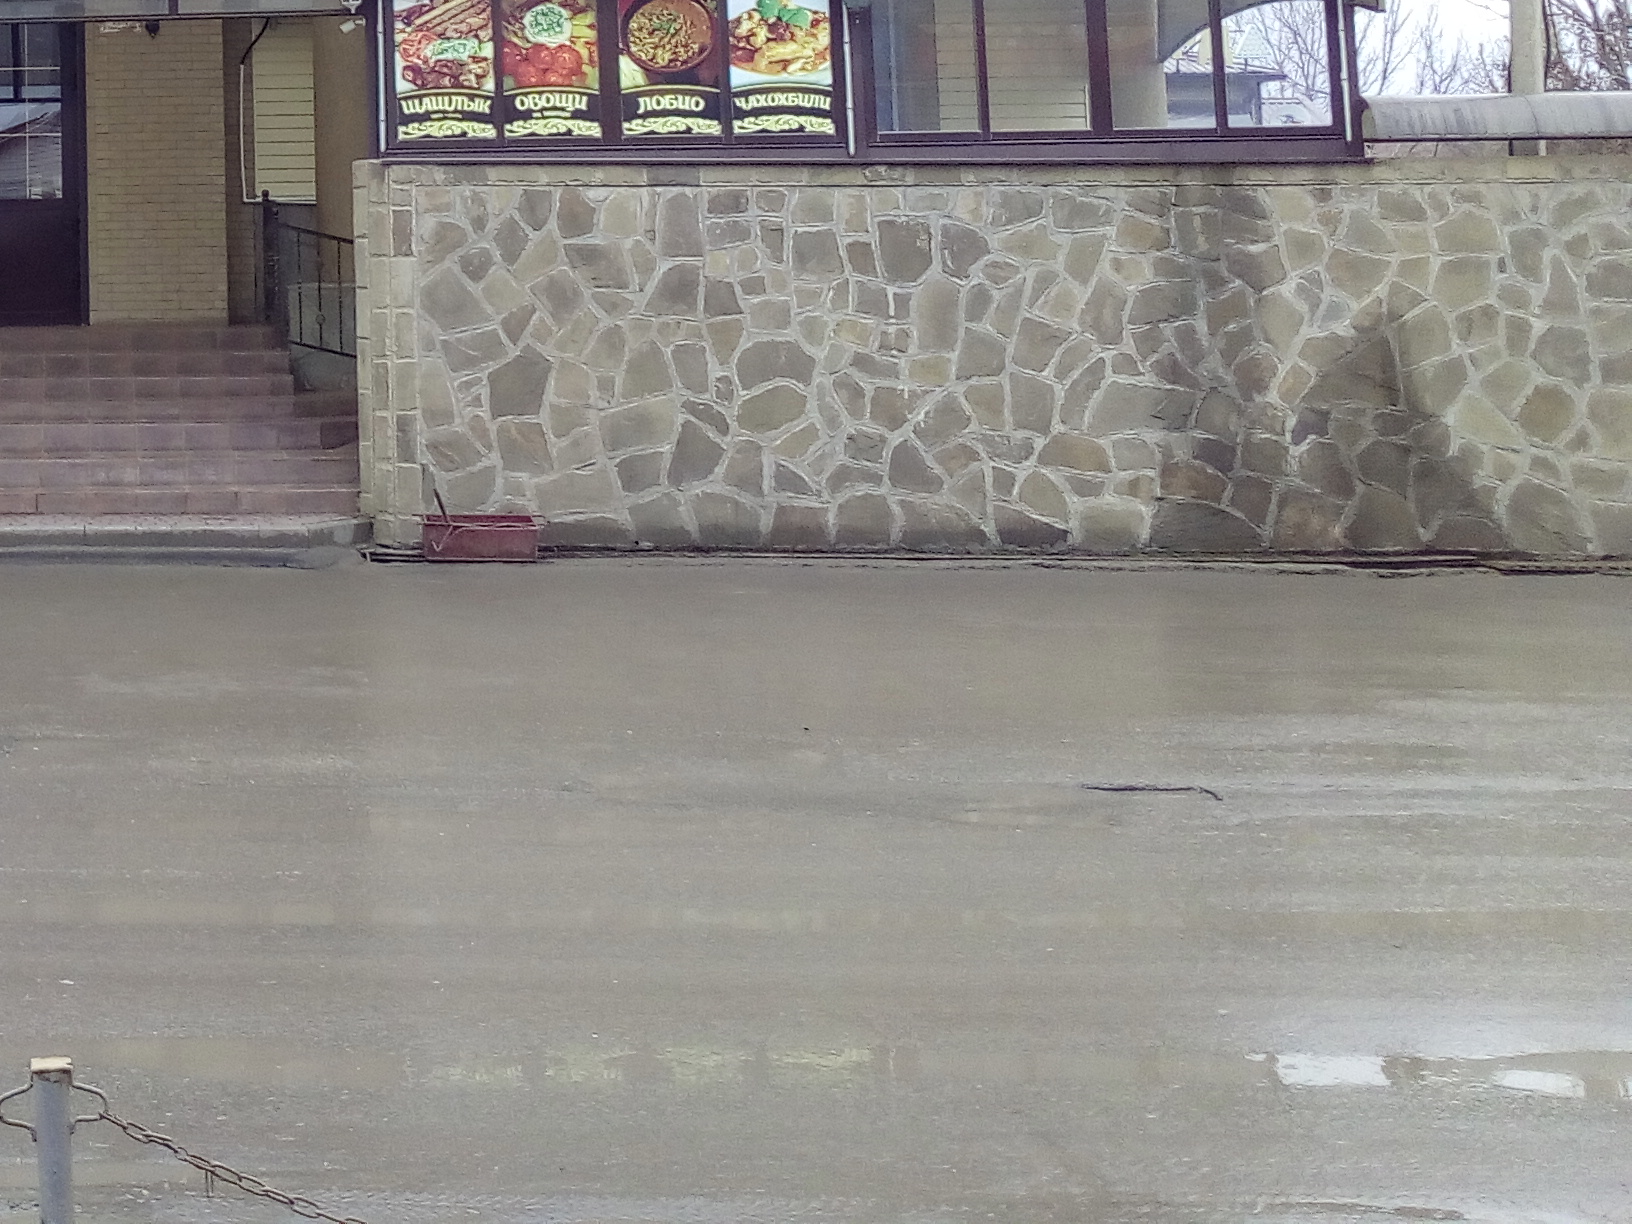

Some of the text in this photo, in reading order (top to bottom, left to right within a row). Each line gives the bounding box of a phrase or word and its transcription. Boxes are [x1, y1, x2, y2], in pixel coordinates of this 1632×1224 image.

[400, 95, 492, 114] ШАШЛЫК
[514, 93, 588, 111] ОВОЩИ
[636, 95, 706, 114] ЛОБИО
[733, 93, 832, 111] ЧАХОХБИЛИ
